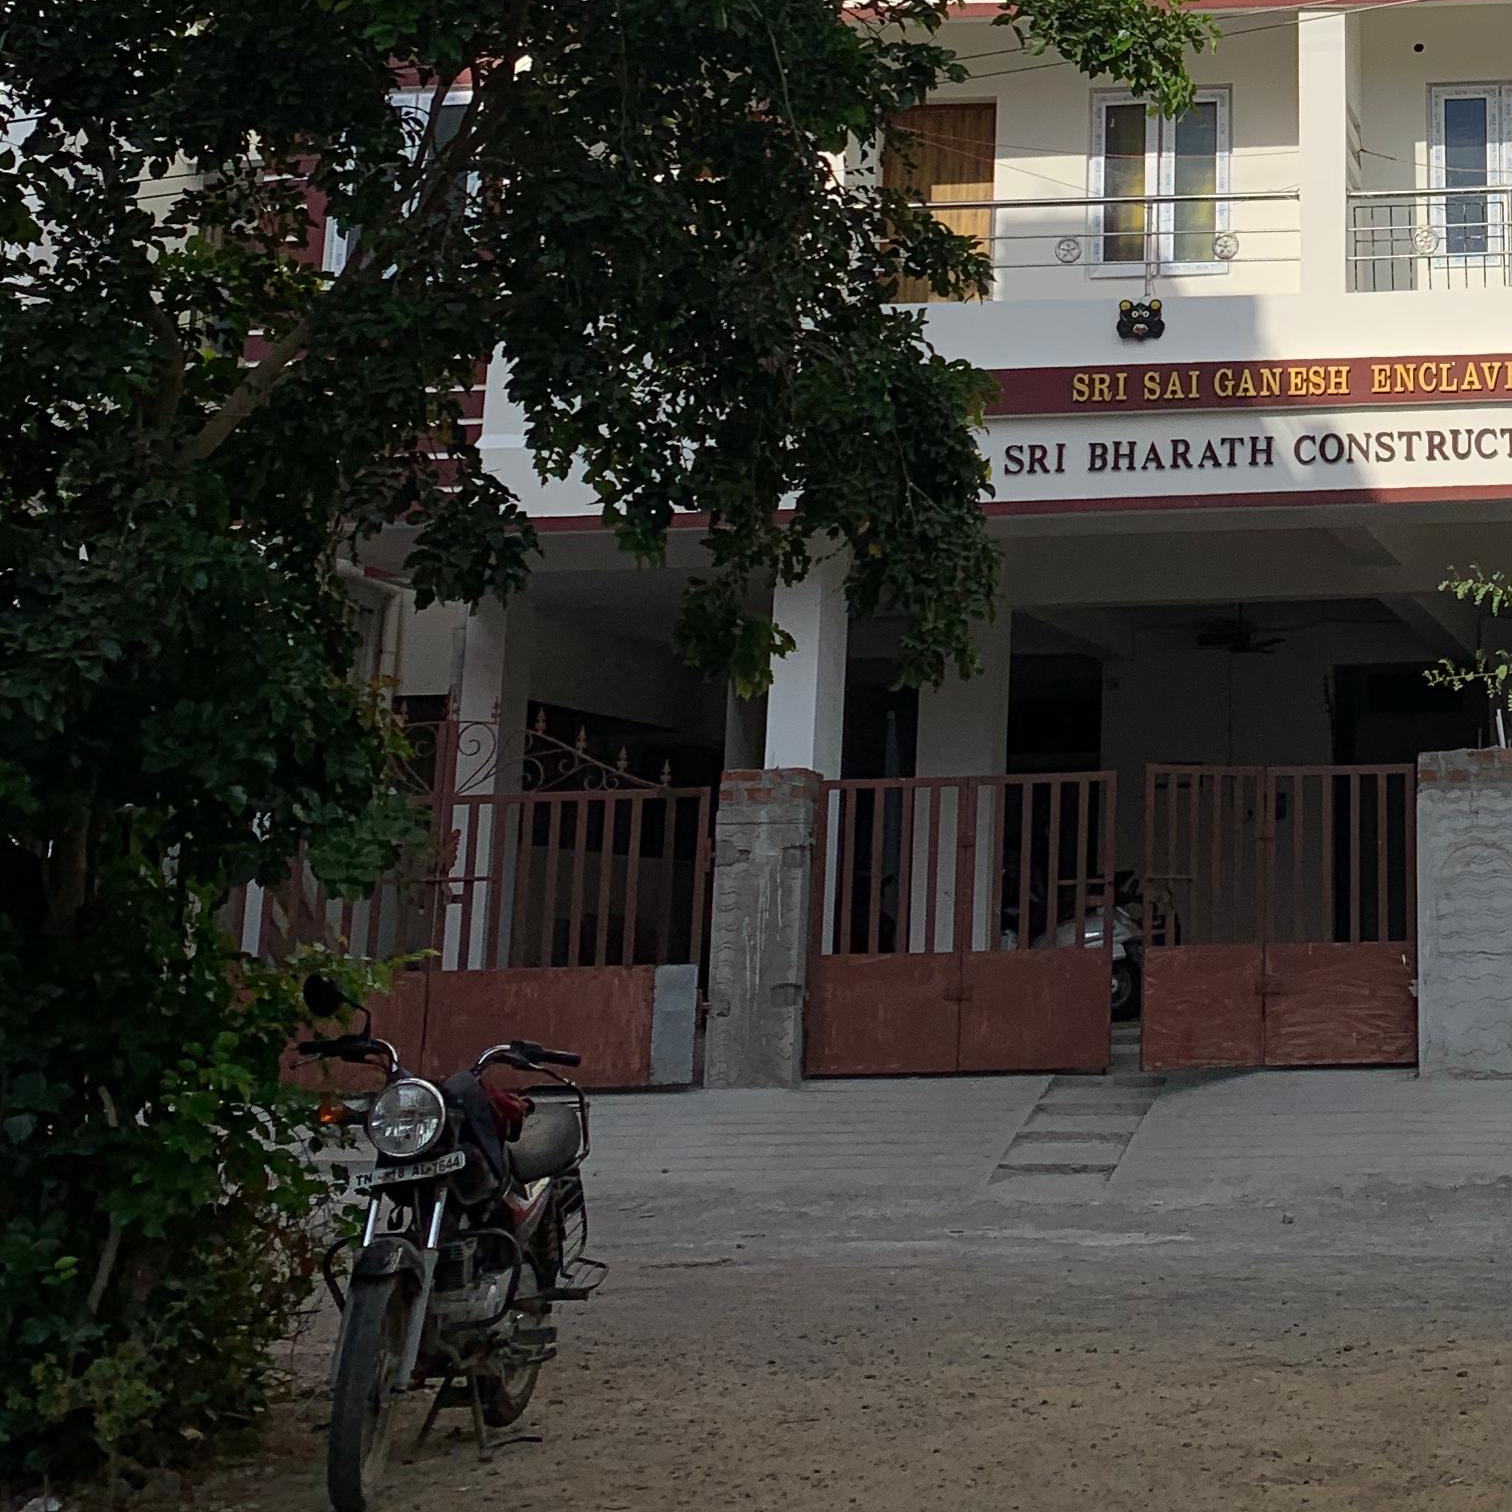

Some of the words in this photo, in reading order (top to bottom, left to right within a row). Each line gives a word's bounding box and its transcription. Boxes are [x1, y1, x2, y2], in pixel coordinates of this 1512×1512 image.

[1072, 372, 1127, 402] SRI
[1144, 370, 1200, 400] SAI
[1213, 365, 1350, 398] GANESH
[1004, 443, 1066, 475] SRI
[1087, 436, 1274, 472] BHARATH
[356, 1173, 373, 1185] TN
